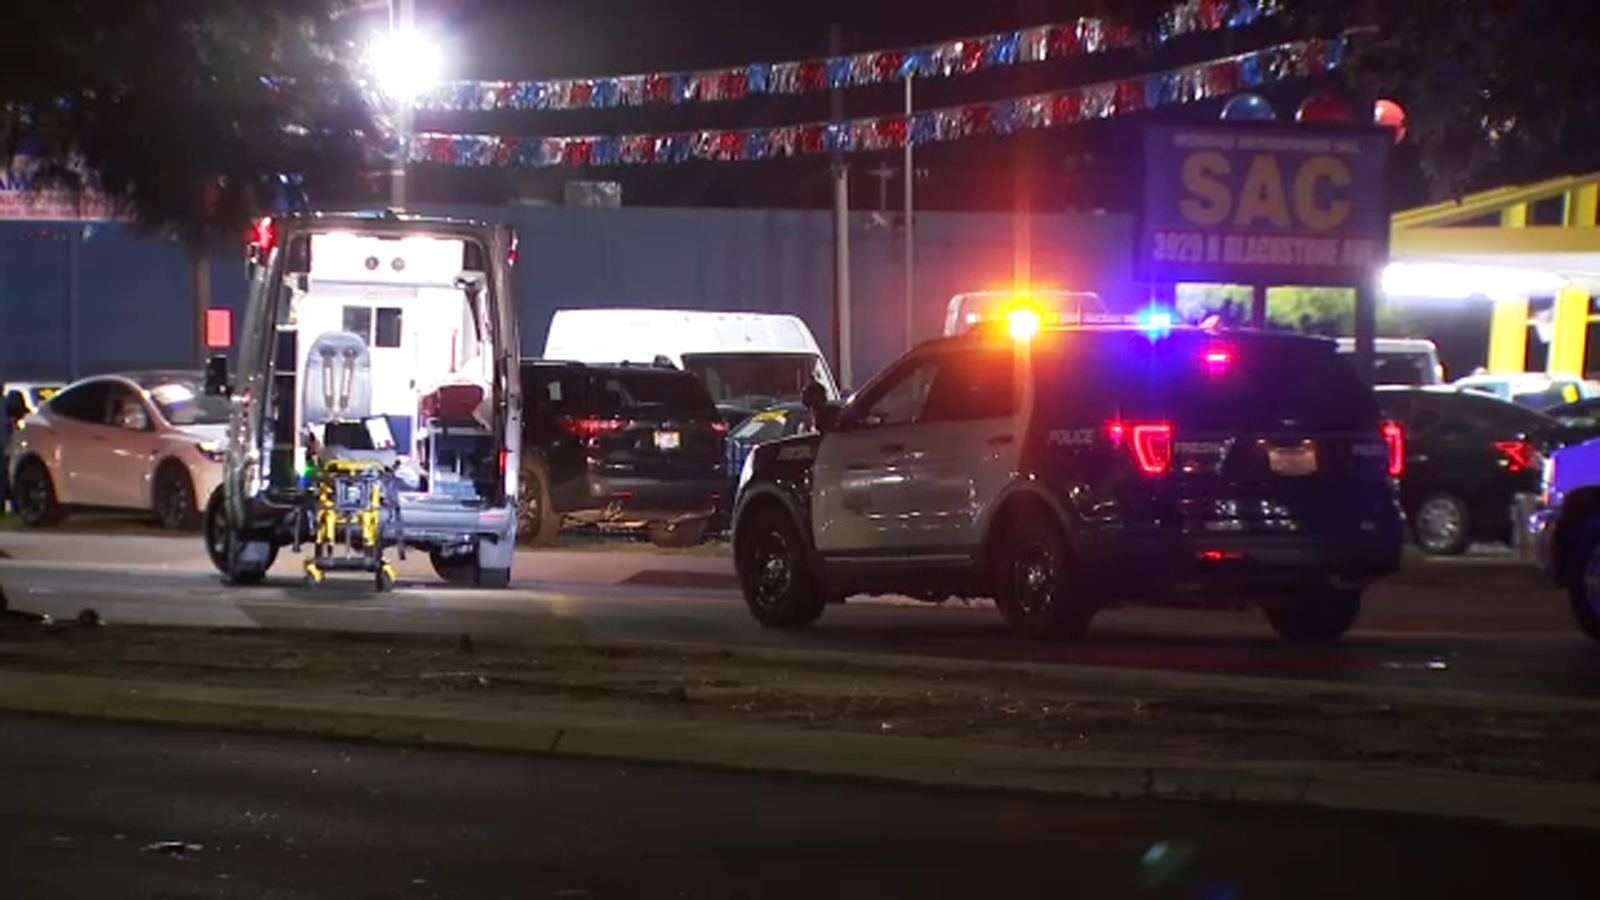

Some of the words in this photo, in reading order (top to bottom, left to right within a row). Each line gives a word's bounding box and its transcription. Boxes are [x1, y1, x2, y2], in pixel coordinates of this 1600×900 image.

[1180, 151, 1351, 230] SAC
[1223, 234, 1339, 266] BLACKSTONE
[1047, 429, 1094, 446] POLICE
